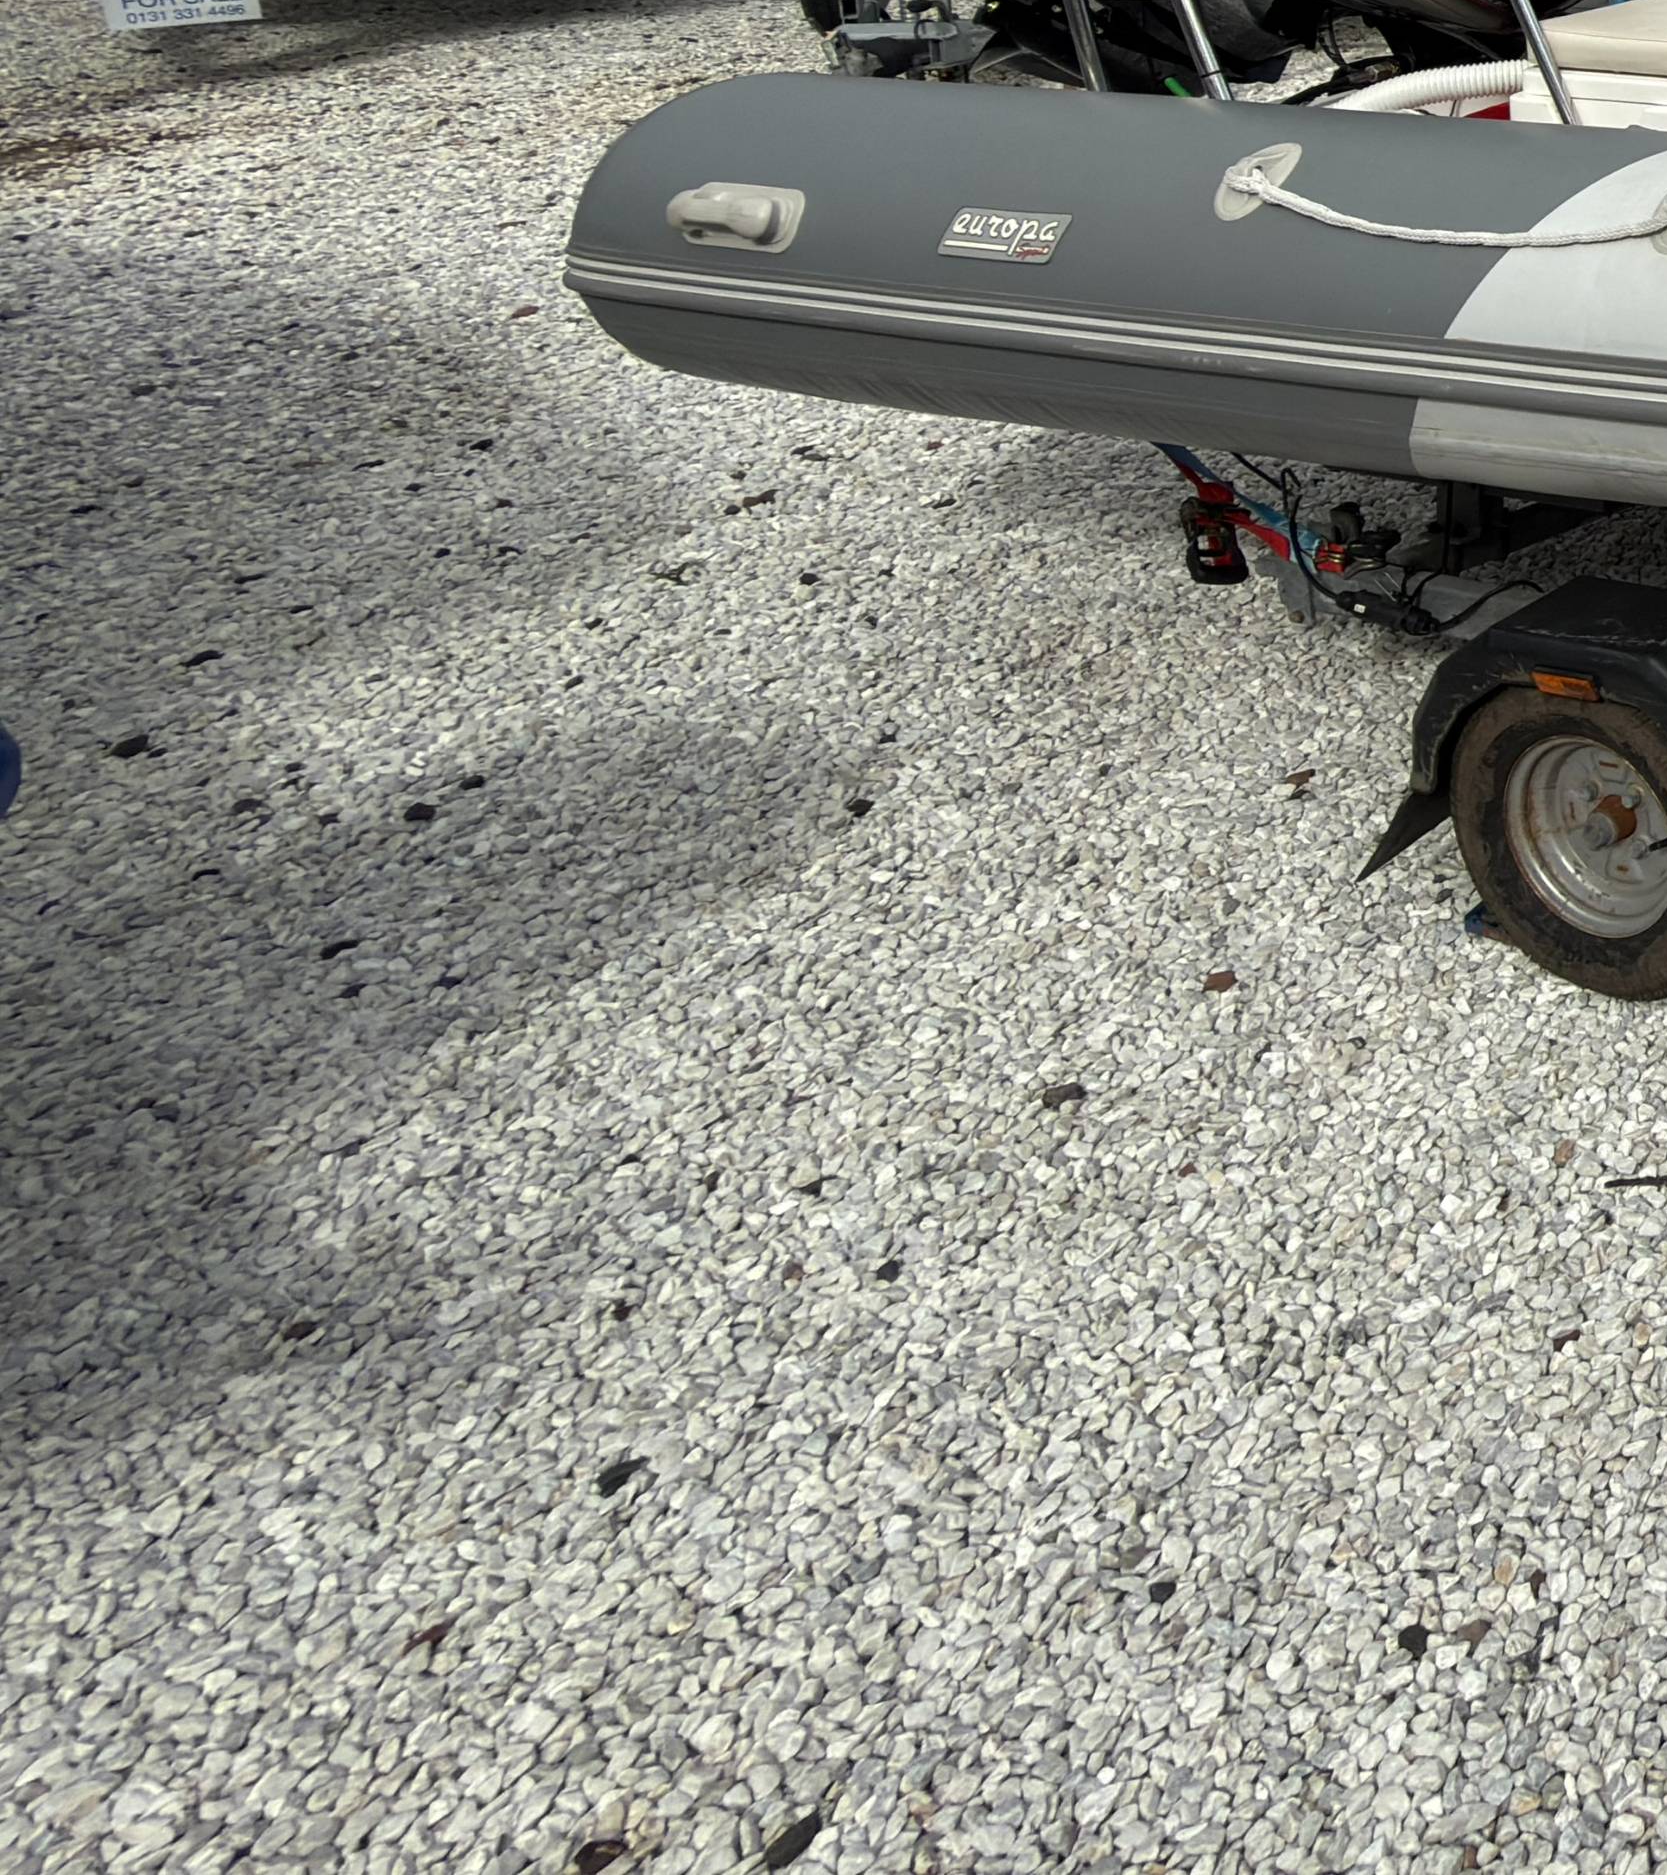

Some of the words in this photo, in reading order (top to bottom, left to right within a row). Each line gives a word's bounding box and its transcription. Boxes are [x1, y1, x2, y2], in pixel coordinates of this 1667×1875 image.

[126, 11, 167, 24] 0131
[173, 8, 202, 20] 331
[952, 212, 1058, 256] europa
